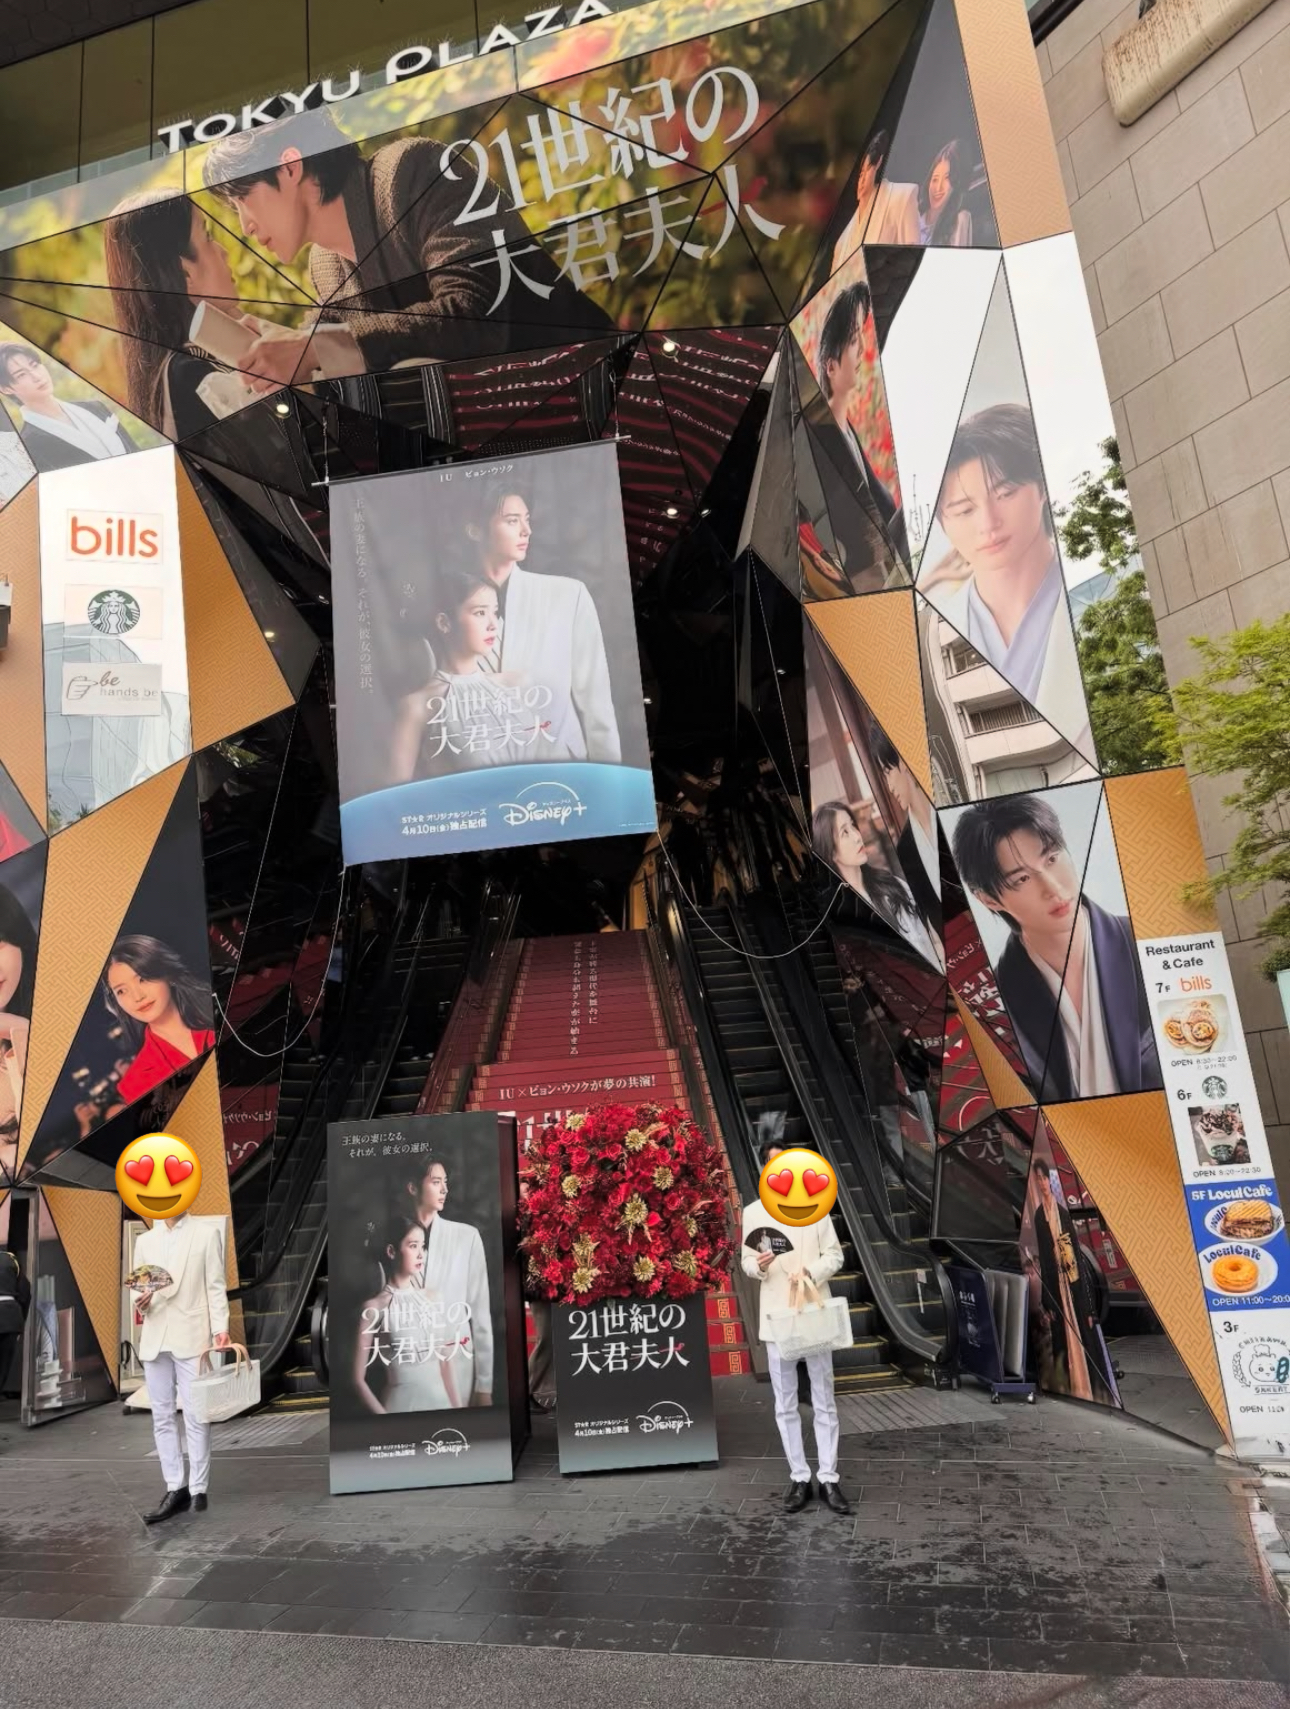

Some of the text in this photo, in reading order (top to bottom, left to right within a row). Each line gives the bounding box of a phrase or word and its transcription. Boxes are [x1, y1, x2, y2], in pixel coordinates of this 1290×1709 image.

[158, 0, 613, 153] TOKYU PLAZA
[439, 66, 760, 226] 21世紀の
[469, 164, 786, 316] 大君夫人
[71, 516, 158, 557] bills
[99, 670, 121, 687] be
[100, 687, 139, 698] hands
[426, 685, 553, 725] 21世紀の
[429, 715, 557, 759] 大君夫人
[1145, 939, 1216, 957] Restaurant
[1162, 957, 1204, 970] & Cafe
[1180, 975, 1212, 992] bills
[1171, 1059, 1193, 1067] OPEN
[1193, 1169, 1216, 1178] OPEN
[1192, 1190, 1206, 1200] 5F
[1212, 1297, 1239, 1307] OPEN
[361, 1301, 472, 1335] 21世紀の
[568, 1303, 686, 1340] 21世紀の
[1223, 1321, 1239, 1333] 3F
[363, 1331, 473, 1368] 大君夫人
[571, 1336, 690, 1377] 大君夫人
[1240, 1405, 1263, 1413] OPEN
